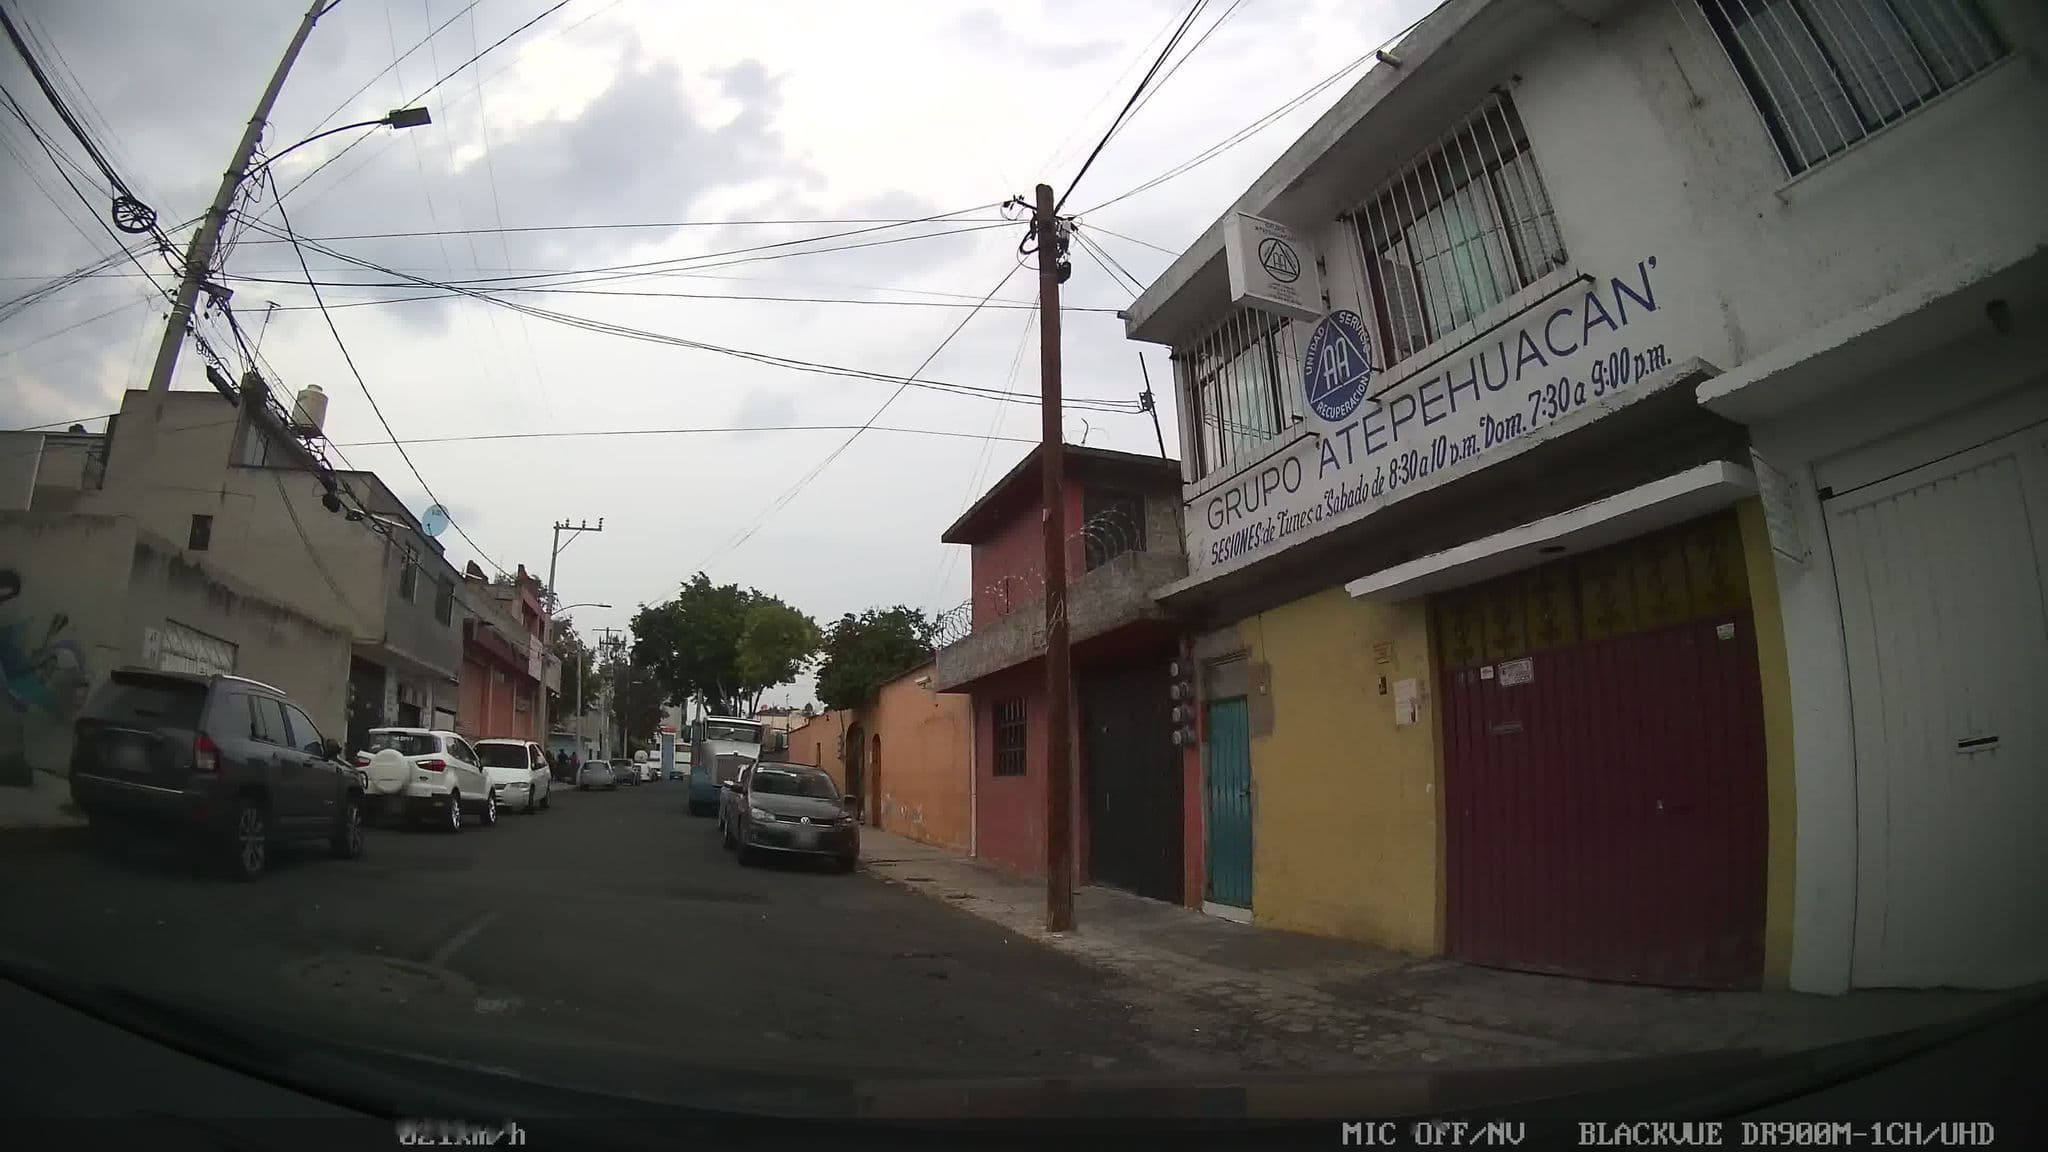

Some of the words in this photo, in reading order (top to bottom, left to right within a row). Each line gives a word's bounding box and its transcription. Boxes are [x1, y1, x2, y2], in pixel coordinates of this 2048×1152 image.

[1305, 327, 1325, 375] UNIDAD
[1323, 336, 1351, 390] AA
[1316, 376, 1369, 418] RECUPERACION
[1263, 517, 1276, 544] de
[1315, 503, 1323, 522] a
[1371, 466, 1385, 498] de
[1389, 449, 1418, 490] 8:30
[1419, 455, 1428, 477] a
[1431, 435, 1447, 473] 10
[1450, 434, 1480, 466] p.m.
[1528, 377, 1570, 426] 7:30
[1574, 381, 1587, 406] a
[1591, 347, 1630, 396] 9:00
[1634, 344, 1671, 384] p.m.
[1207, 456, 1302, 530] GRUPO
